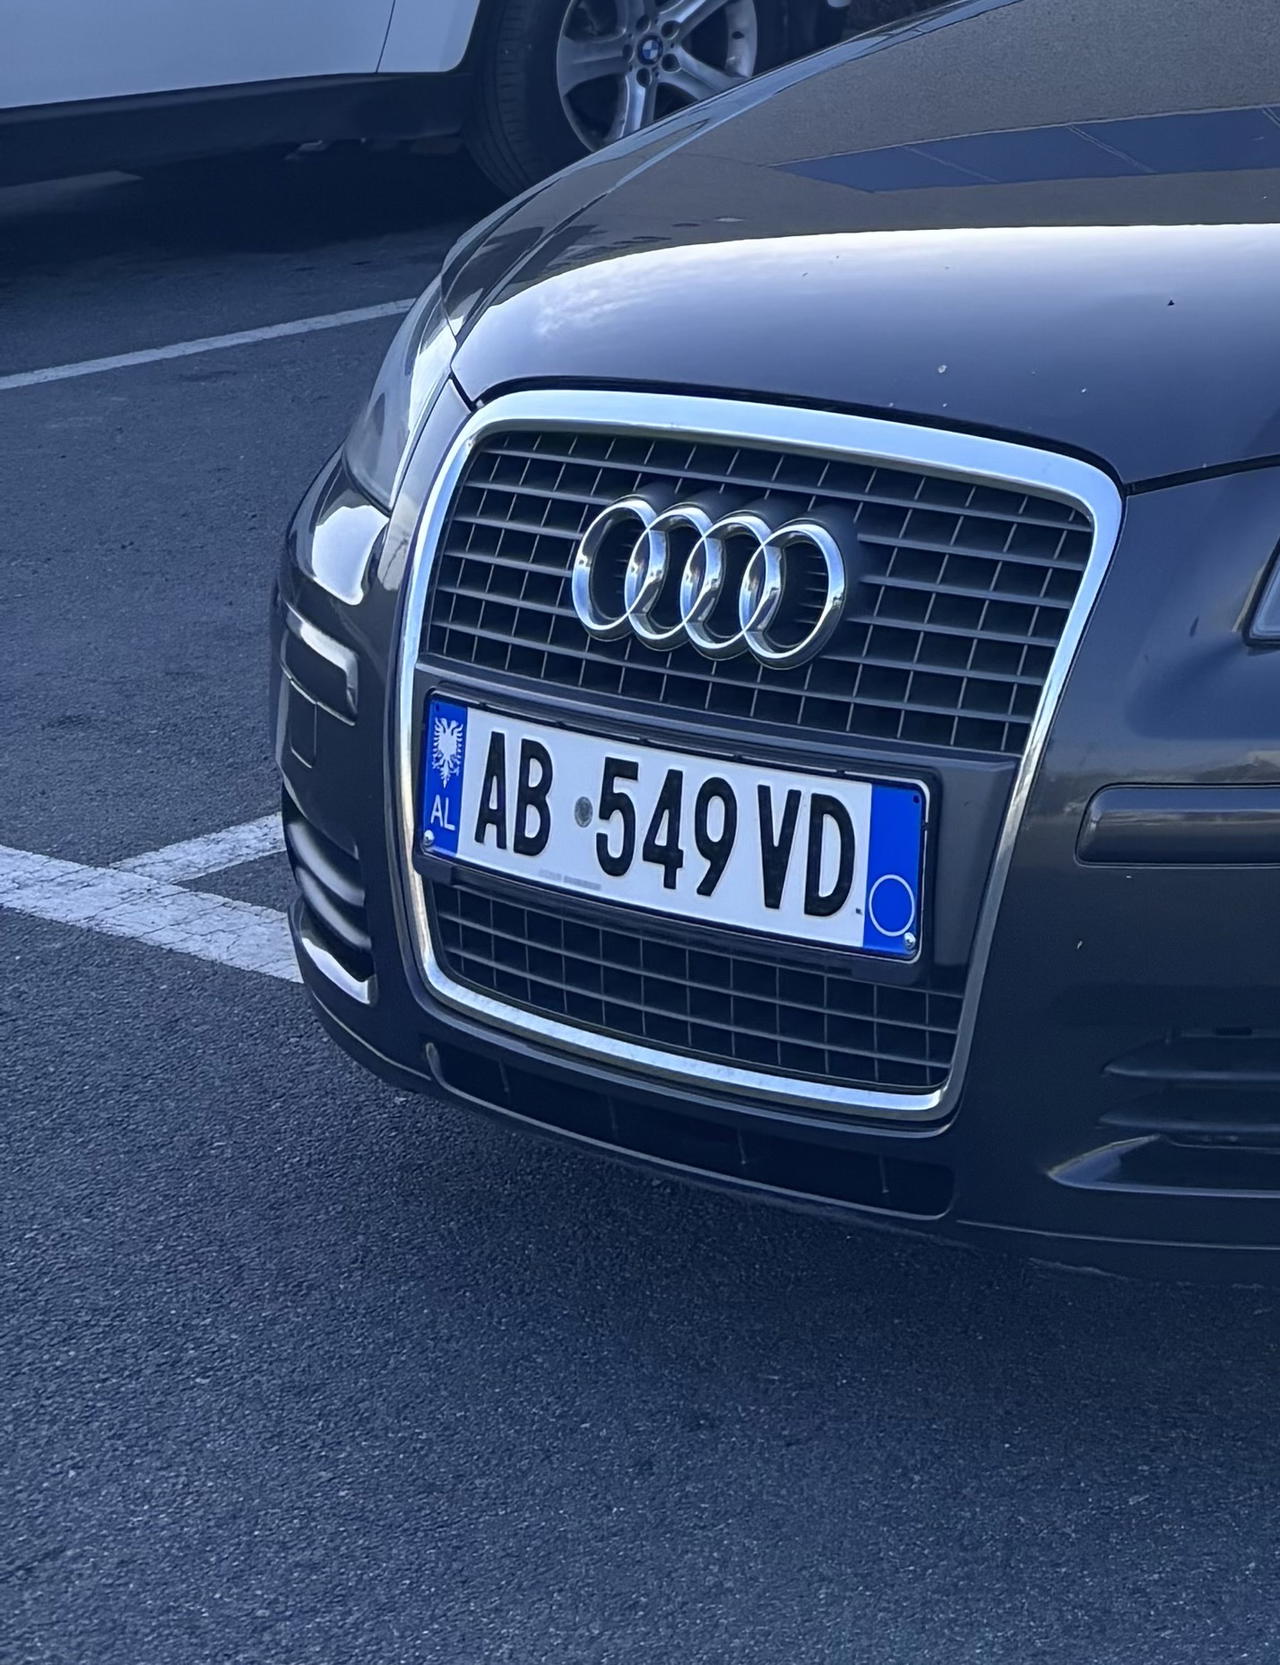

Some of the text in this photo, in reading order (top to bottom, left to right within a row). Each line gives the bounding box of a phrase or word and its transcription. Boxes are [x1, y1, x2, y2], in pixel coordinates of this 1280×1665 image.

[430, 794, 456, 831] AL
[474, 731, 857, 917] AB 549 VD
